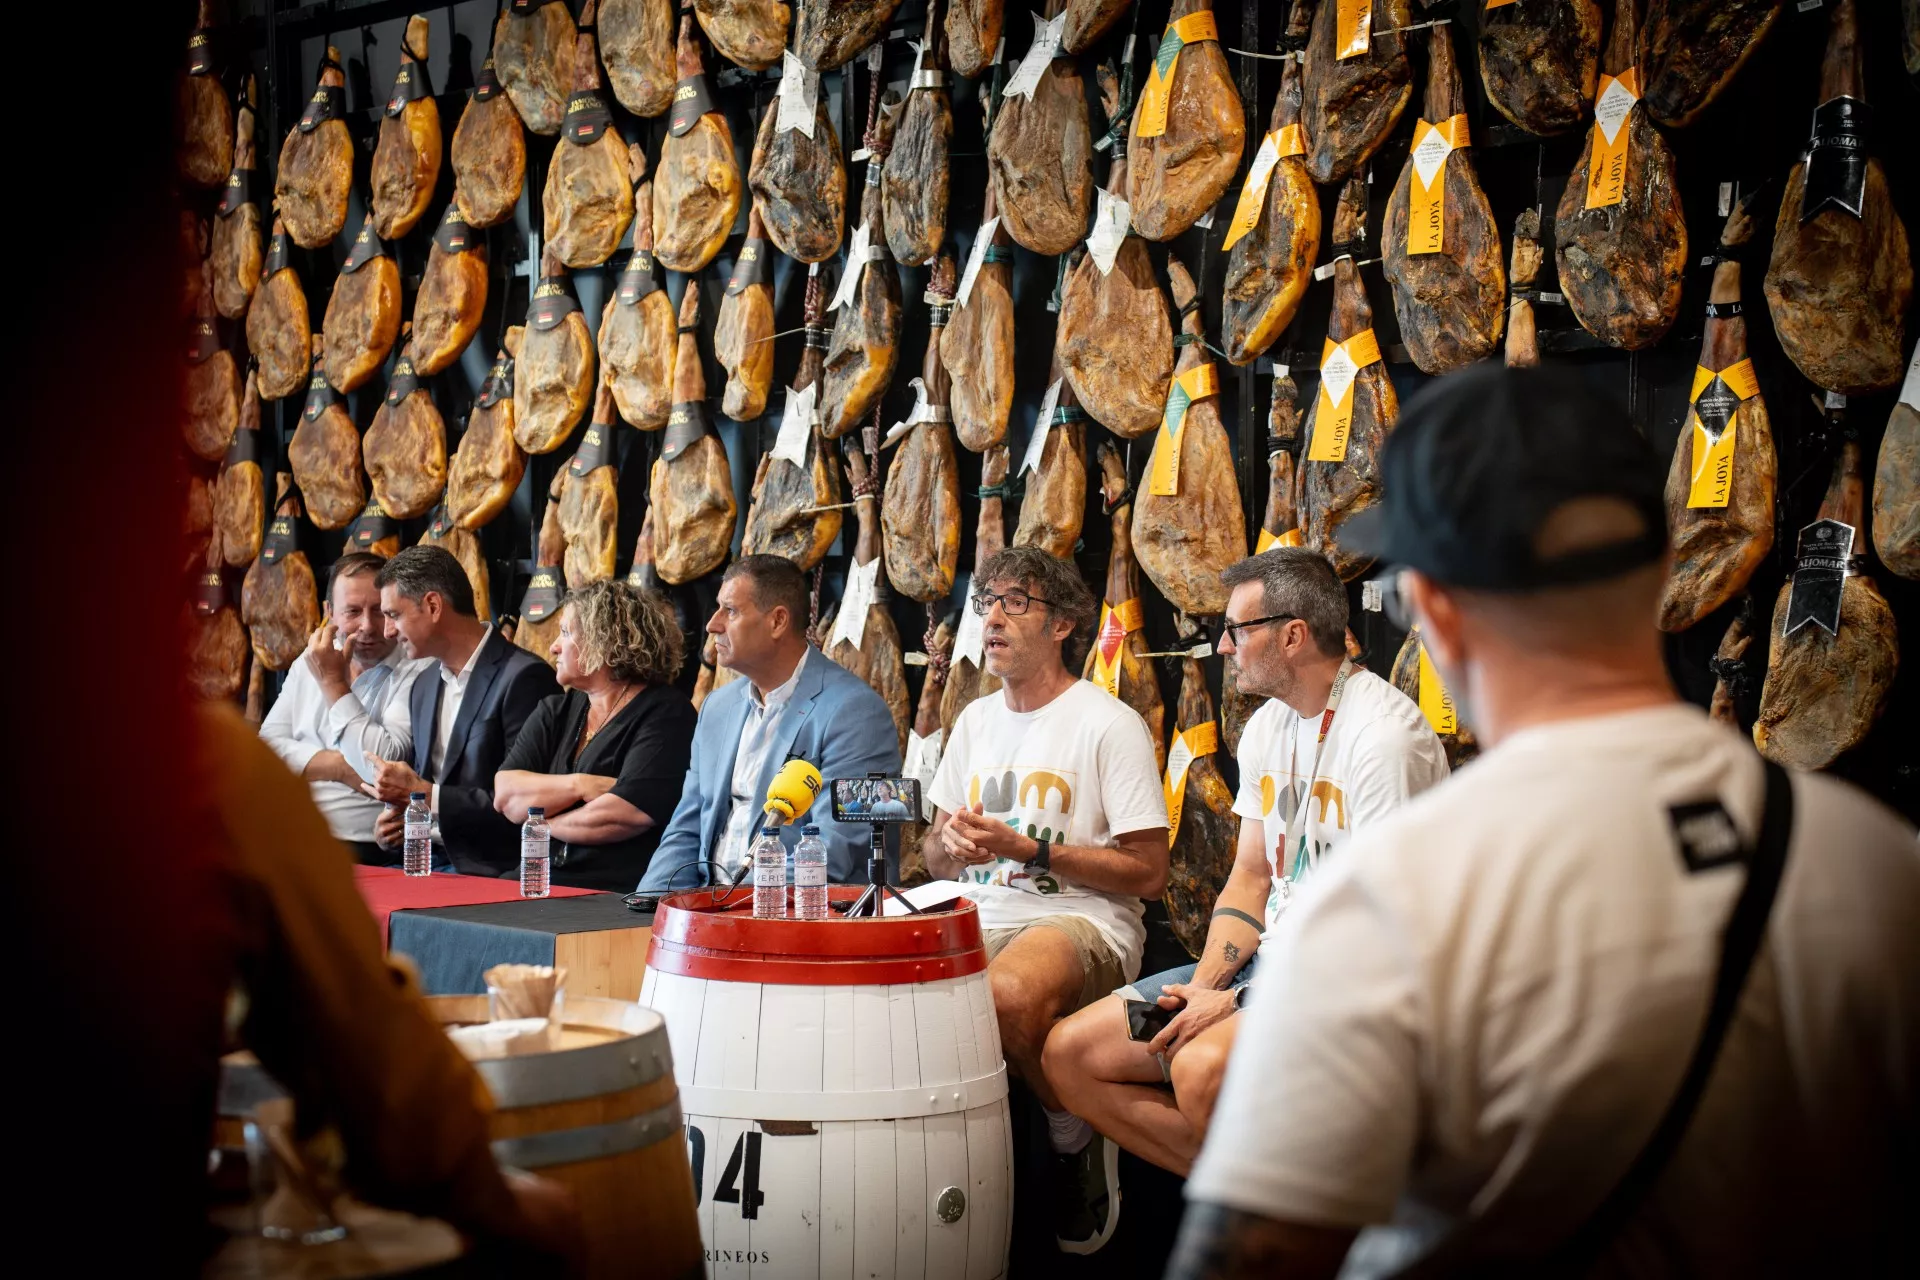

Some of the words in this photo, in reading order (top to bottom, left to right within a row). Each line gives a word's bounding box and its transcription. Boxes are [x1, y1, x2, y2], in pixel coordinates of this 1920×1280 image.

[1611, 153, 1623, 182] JOYA
[1608, 185, 1619, 200] LA
[1430, 200, 1440, 230] JOYA
[1429, 233, 1439, 248] LA
[1333, 418, 1347, 443] JOYA
[1331, 445, 1342, 457] LA
[1716, 455, 1729, 486] JOYA
[1713, 490, 1726, 503] LA
[1798, 558, 1845, 569] ALJOMAR
[1442, 715, 1453, 729] LA
[1170, 804, 1180, 829] JOYA
